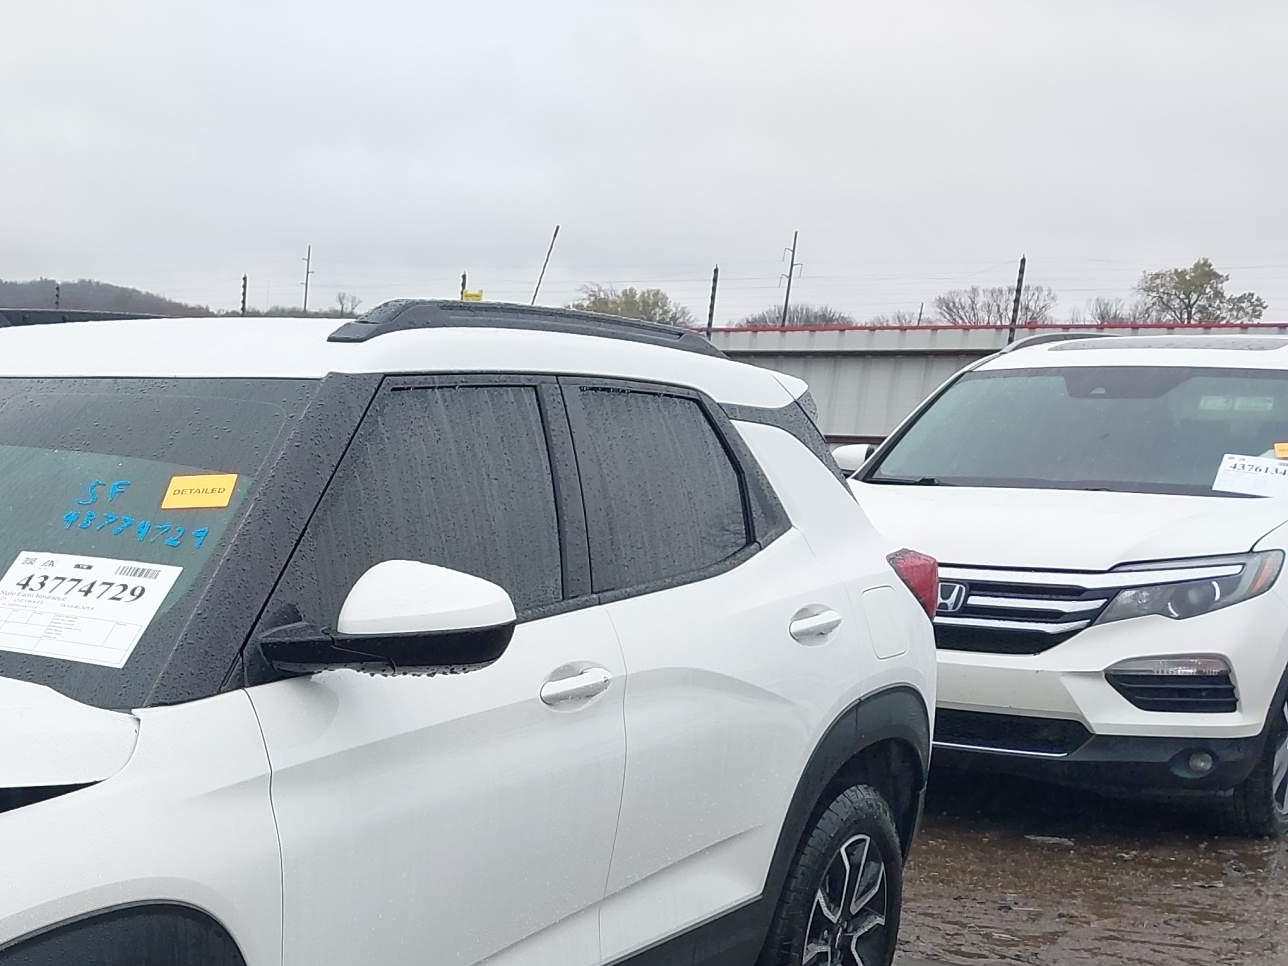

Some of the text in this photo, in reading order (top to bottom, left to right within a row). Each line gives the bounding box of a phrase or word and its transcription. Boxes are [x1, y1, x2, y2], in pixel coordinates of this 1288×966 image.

[76, 479, 132, 506] SF
[172, 486, 227, 496] DETAILED
[15, 573, 146, 603] 43774729
